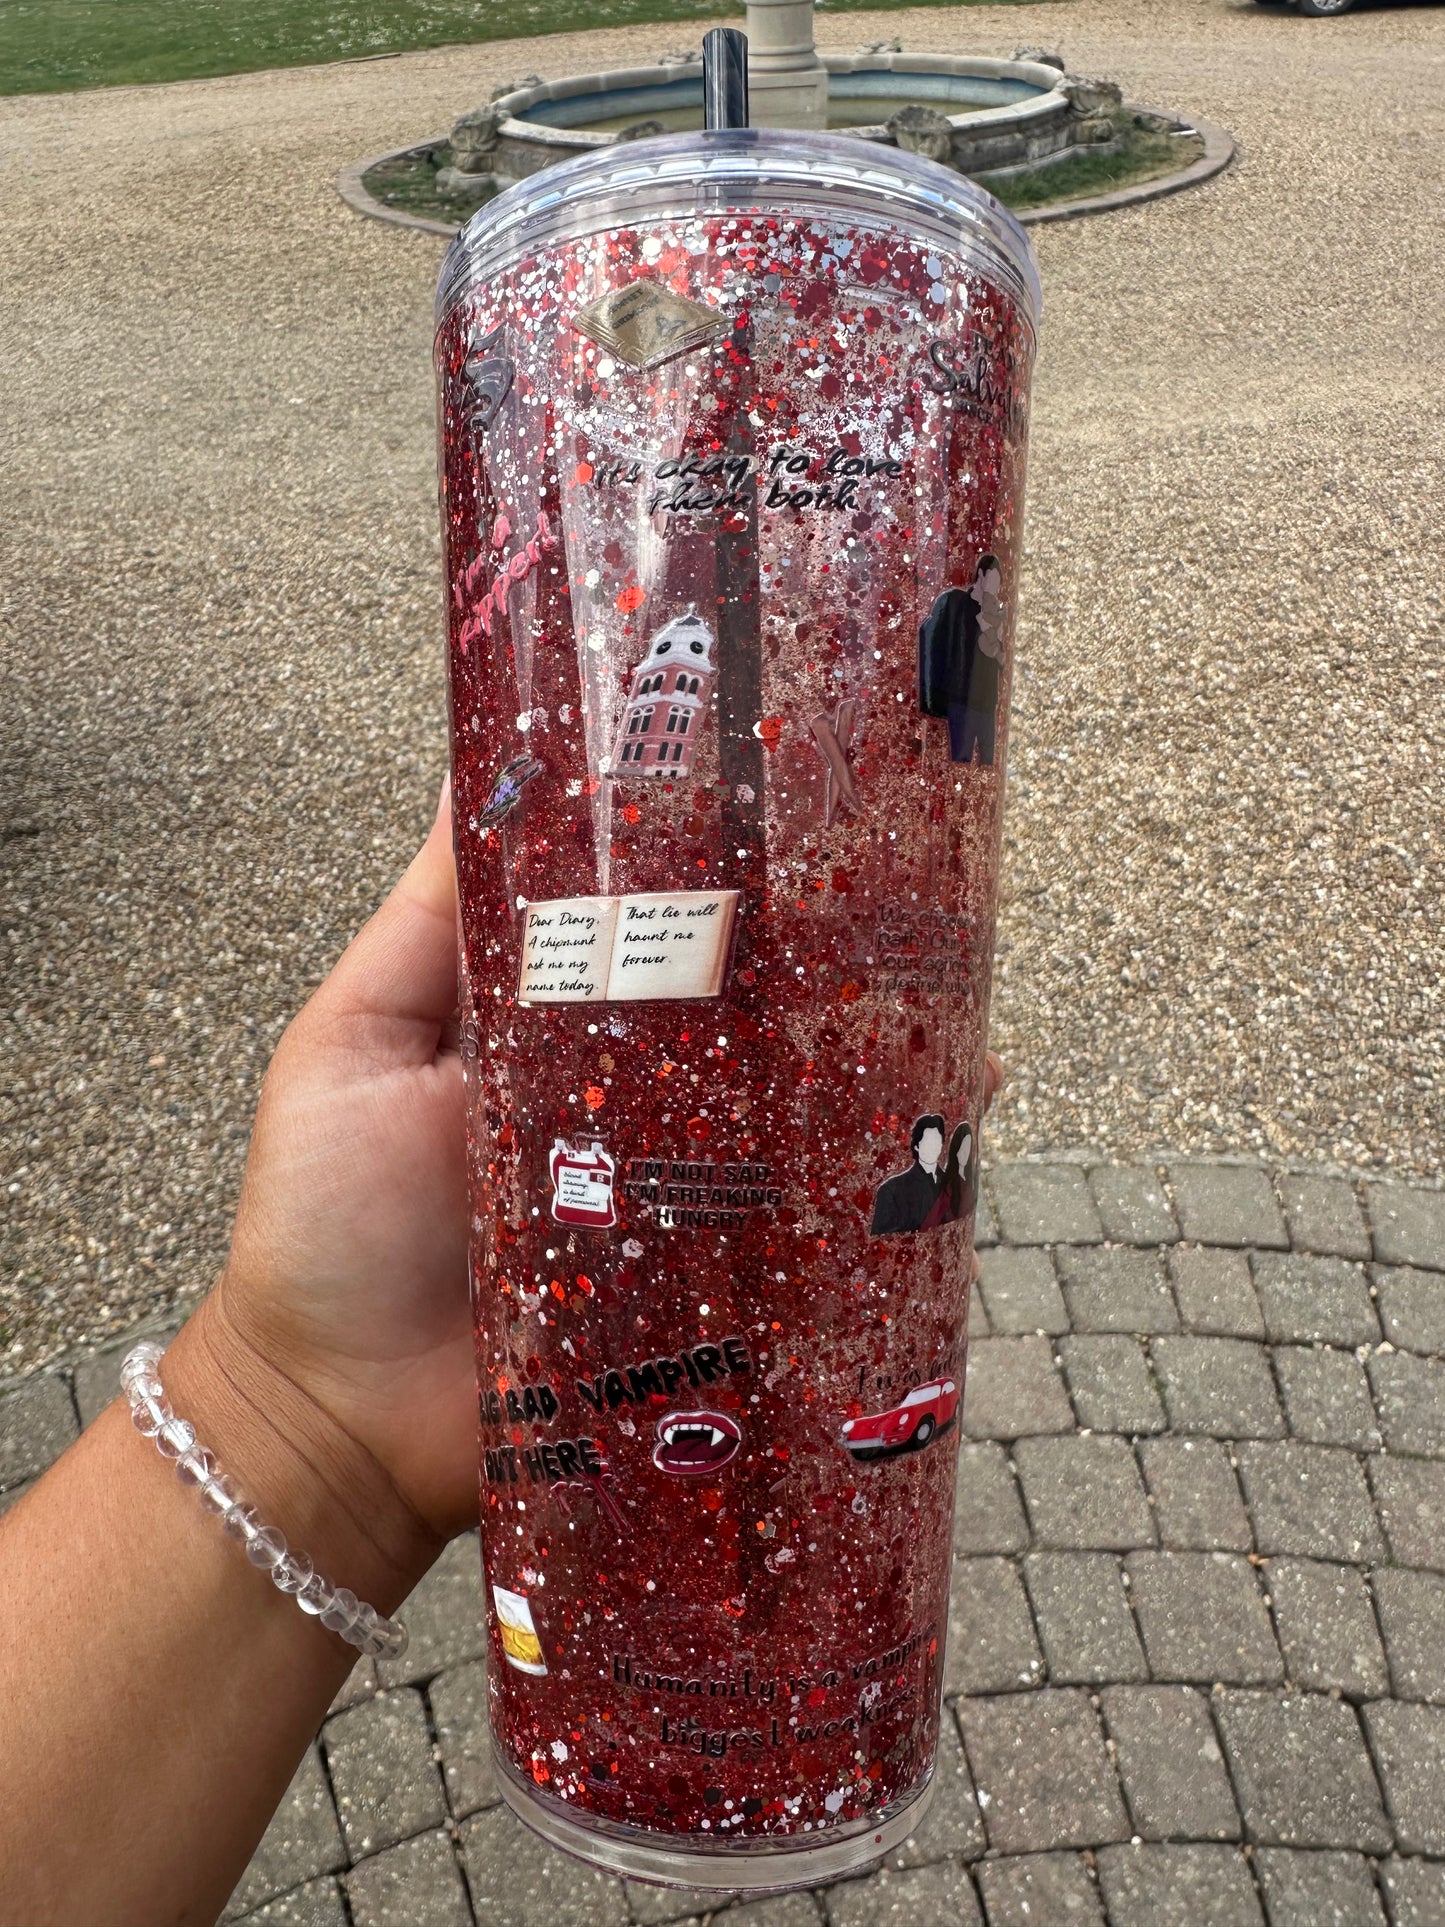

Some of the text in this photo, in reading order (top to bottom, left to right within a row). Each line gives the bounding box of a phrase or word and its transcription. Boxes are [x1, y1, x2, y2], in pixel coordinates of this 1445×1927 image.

[655, 452, 750, 491] okay
[768, 443, 811, 473] to
[822, 447, 905, 479] love
[649, 480, 859, 517] them both
[529, 914, 554, 928] Dear
[626, 903, 719, 920] That lie will
[528, 933, 597, 953] A chipmunk
[624, 929, 696, 943] haunt me
[527, 957, 588, 974] ask me my
[526, 983, 555, 991] name
[630, 1161, 769, 1184] I'M NOT SAD
[625, 1182, 782, 1206] I'M FREAKING
[656, 1207, 749, 1228] HUNGRY
[505, 1384, 559, 1422] BAD
[577, 1337, 752, 1412] VAMPIRE
[524, 1439, 601, 1483] HERE
[613, 1653, 776, 1705] Humanity
[788, 1670, 810, 1692] is
[822, 1671, 838, 1687] a
[661, 1713, 783, 1757] biggest
